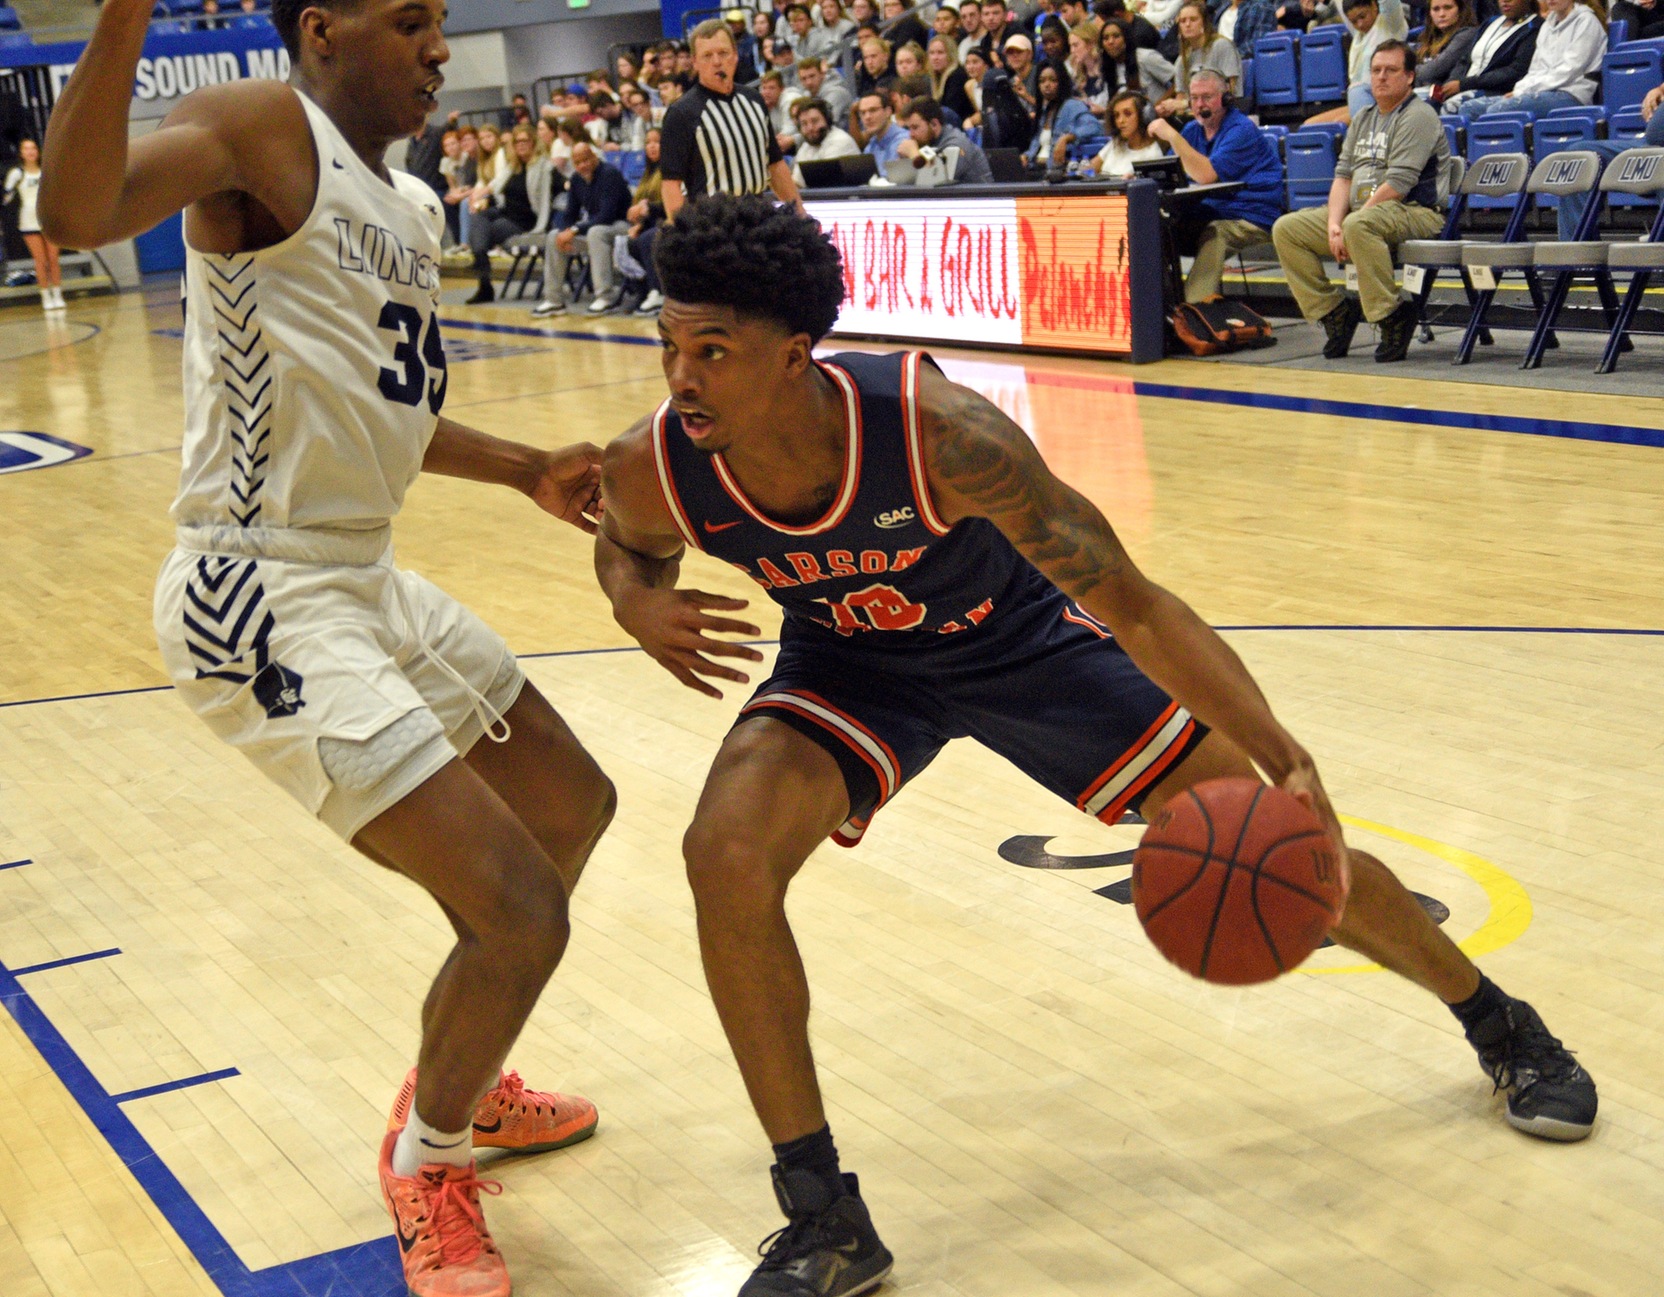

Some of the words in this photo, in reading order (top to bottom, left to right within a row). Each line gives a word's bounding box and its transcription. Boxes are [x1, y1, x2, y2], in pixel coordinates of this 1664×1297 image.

[136, 52, 240, 99] SOUND
[1477, 160, 1517, 187] LMU
[1544, 158, 1587, 186] LMU
[1618, 154, 1664, 183] LMU
[334, 217, 440, 291] LINC
[864, 218, 914, 315] BAR
[878, 506, 915, 525] SAC
